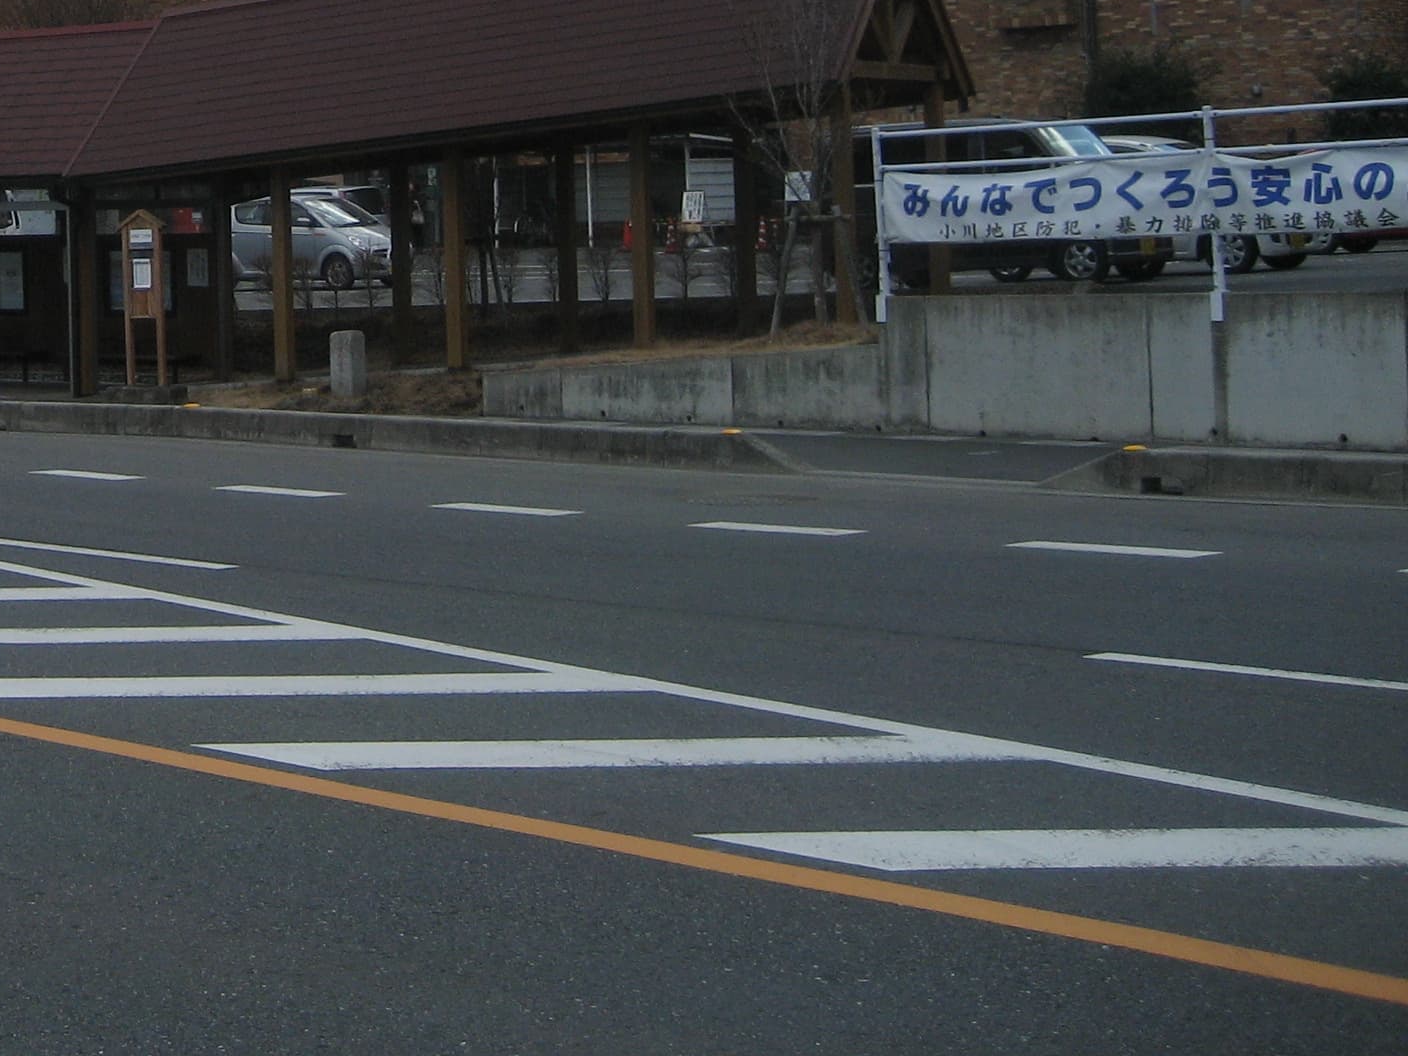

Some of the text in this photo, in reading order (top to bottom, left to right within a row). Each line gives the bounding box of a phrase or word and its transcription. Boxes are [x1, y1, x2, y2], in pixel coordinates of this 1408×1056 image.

[903, 162, 1408, 218] みんなでつくろう安心の
